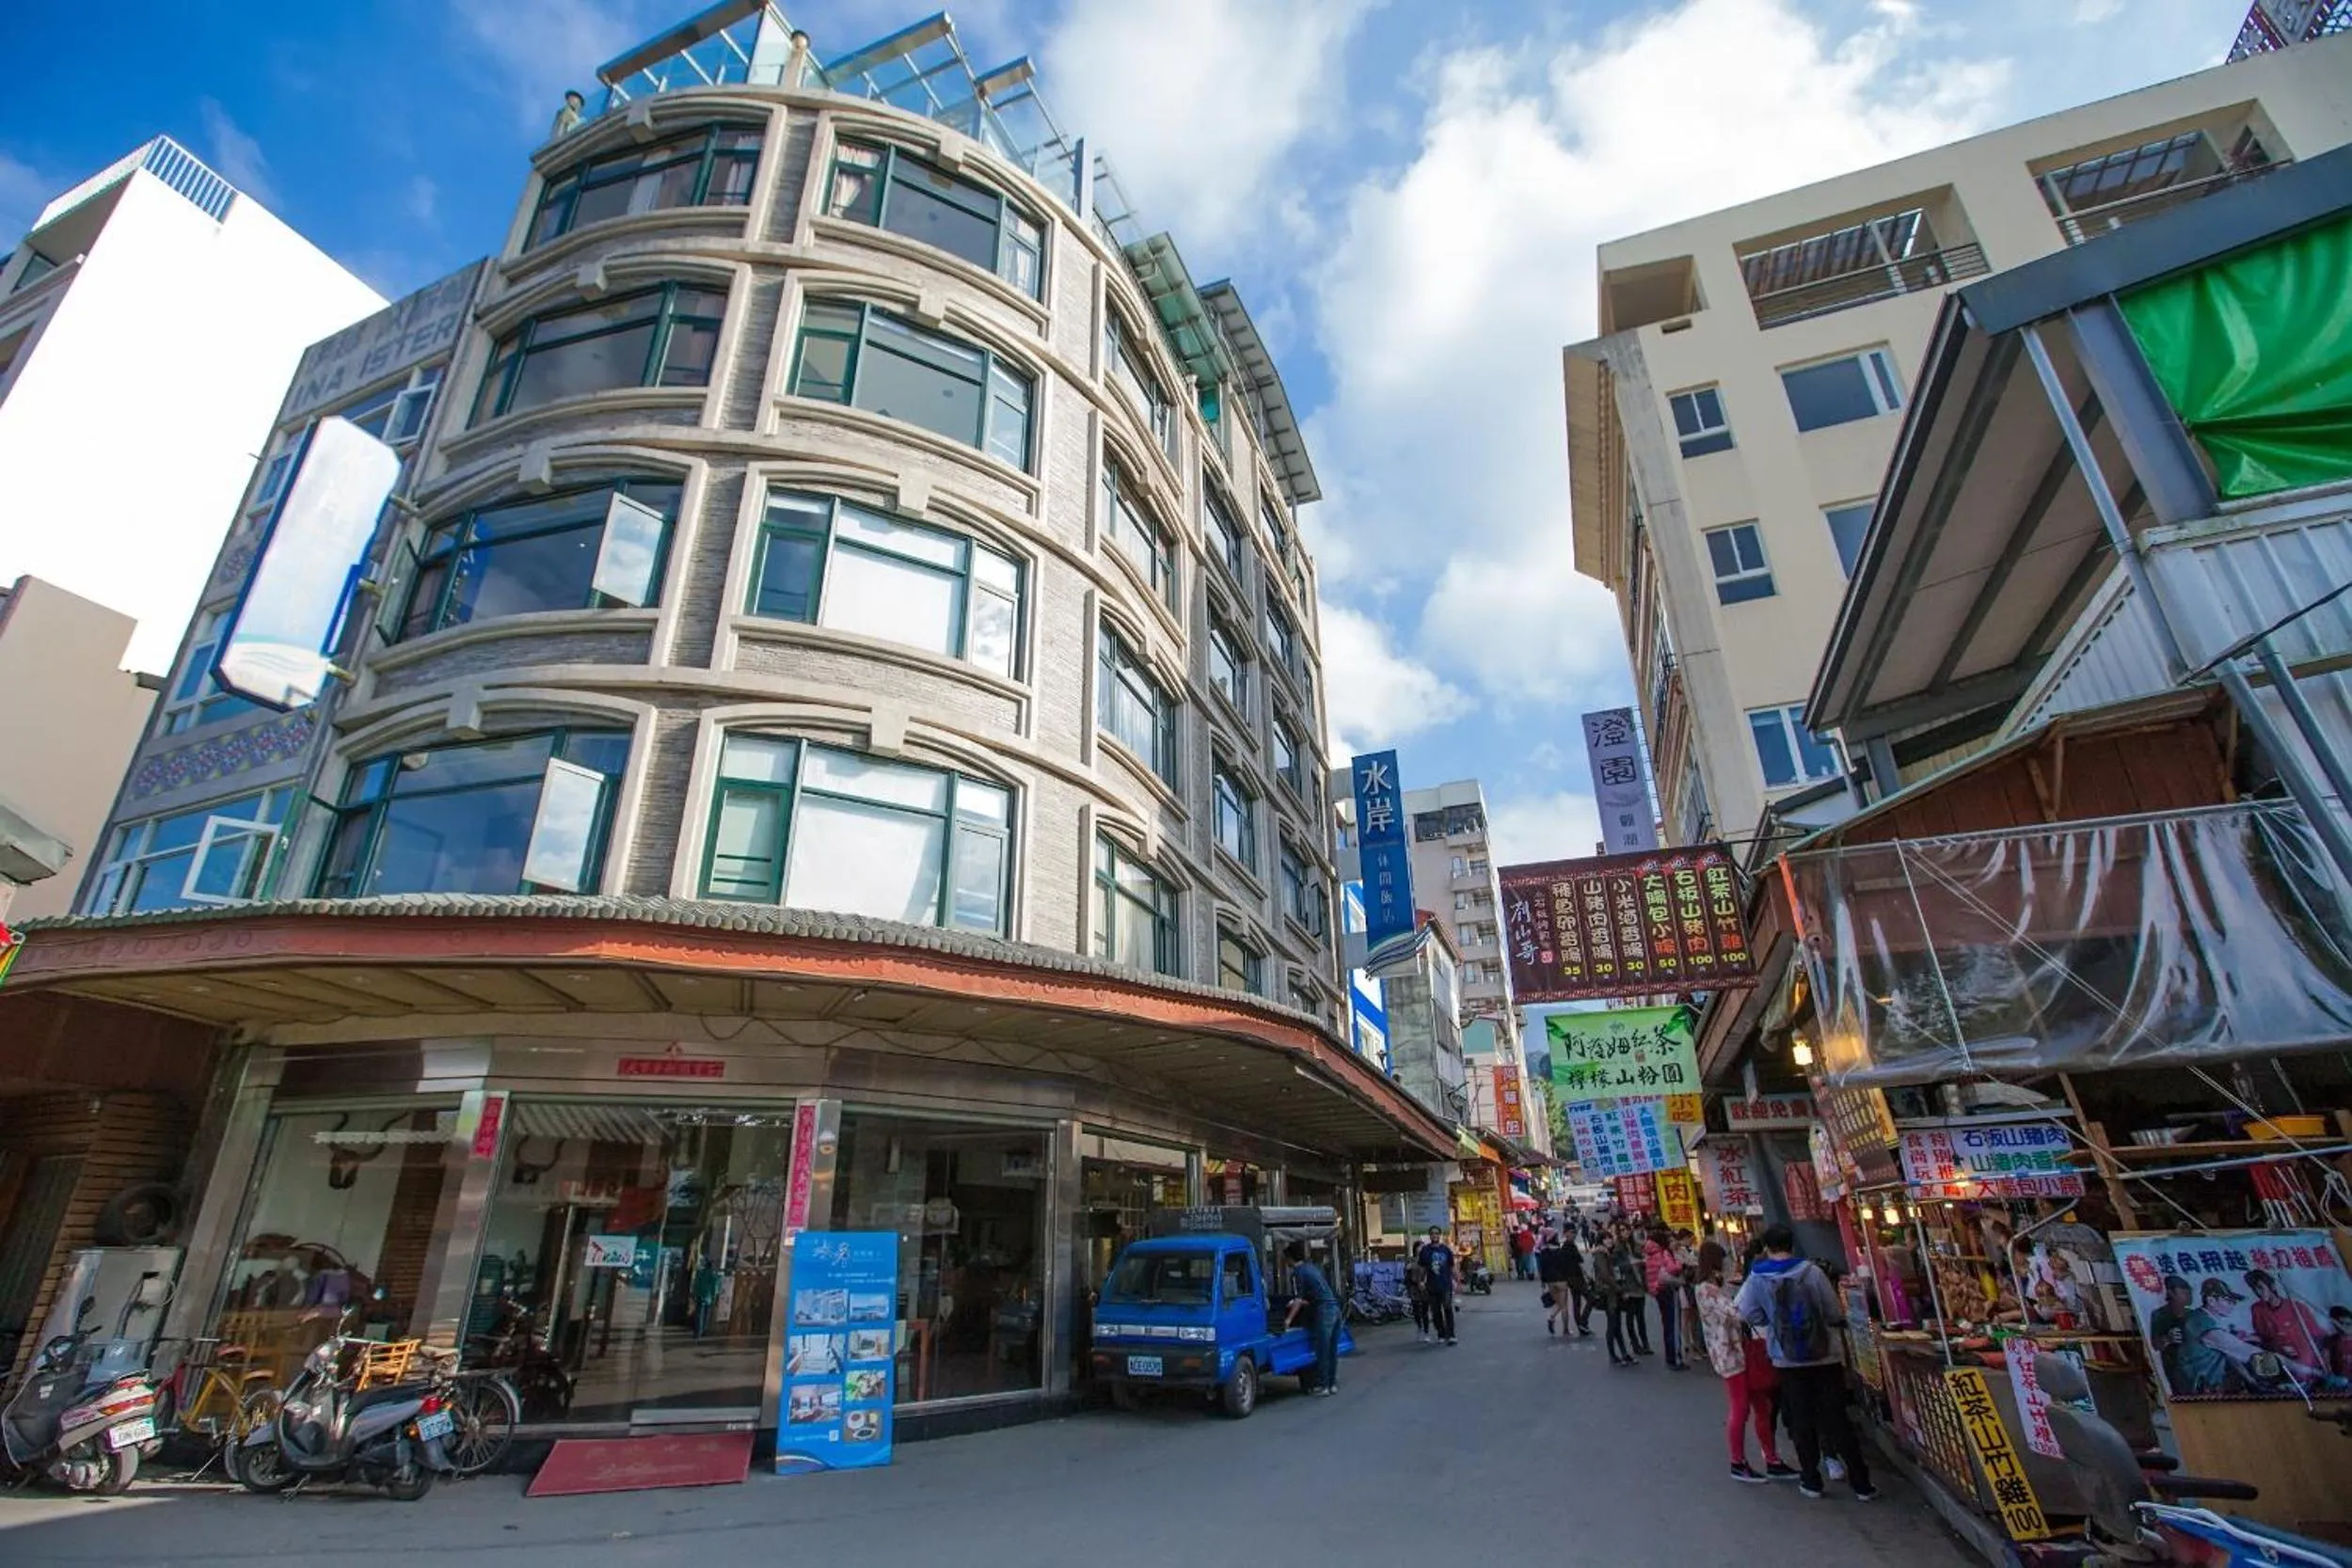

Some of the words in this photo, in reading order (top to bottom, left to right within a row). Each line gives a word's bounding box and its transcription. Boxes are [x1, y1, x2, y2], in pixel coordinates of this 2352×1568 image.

[1360, 760, 1395, 835] 水岸
[1583, 879, 1613, 959] 山豬肉香腸
[1613, 878, 1645, 958] 小米酒香腸
[1644, 874, 1677, 955] 大腸包小腸
[1674, 869, 1708, 953] 石板山豬肉
[1706, 866, 1742, 950] 紅茶山竹雞
[1596, 962, 1613, 974] 30
[1627, 960, 1645, 971] 30
[1688, 955, 1713, 965] 100
[1721, 952, 1746, 962] 100
[1963, 1127, 2067, 1148] 石板山豬肉
[1977, 1177, 2082, 1197] 大腸包小腸
[1950, 1372, 2031, 1507] 紅茶山竹雞
[2007, 1507, 2041, 1533] 100
